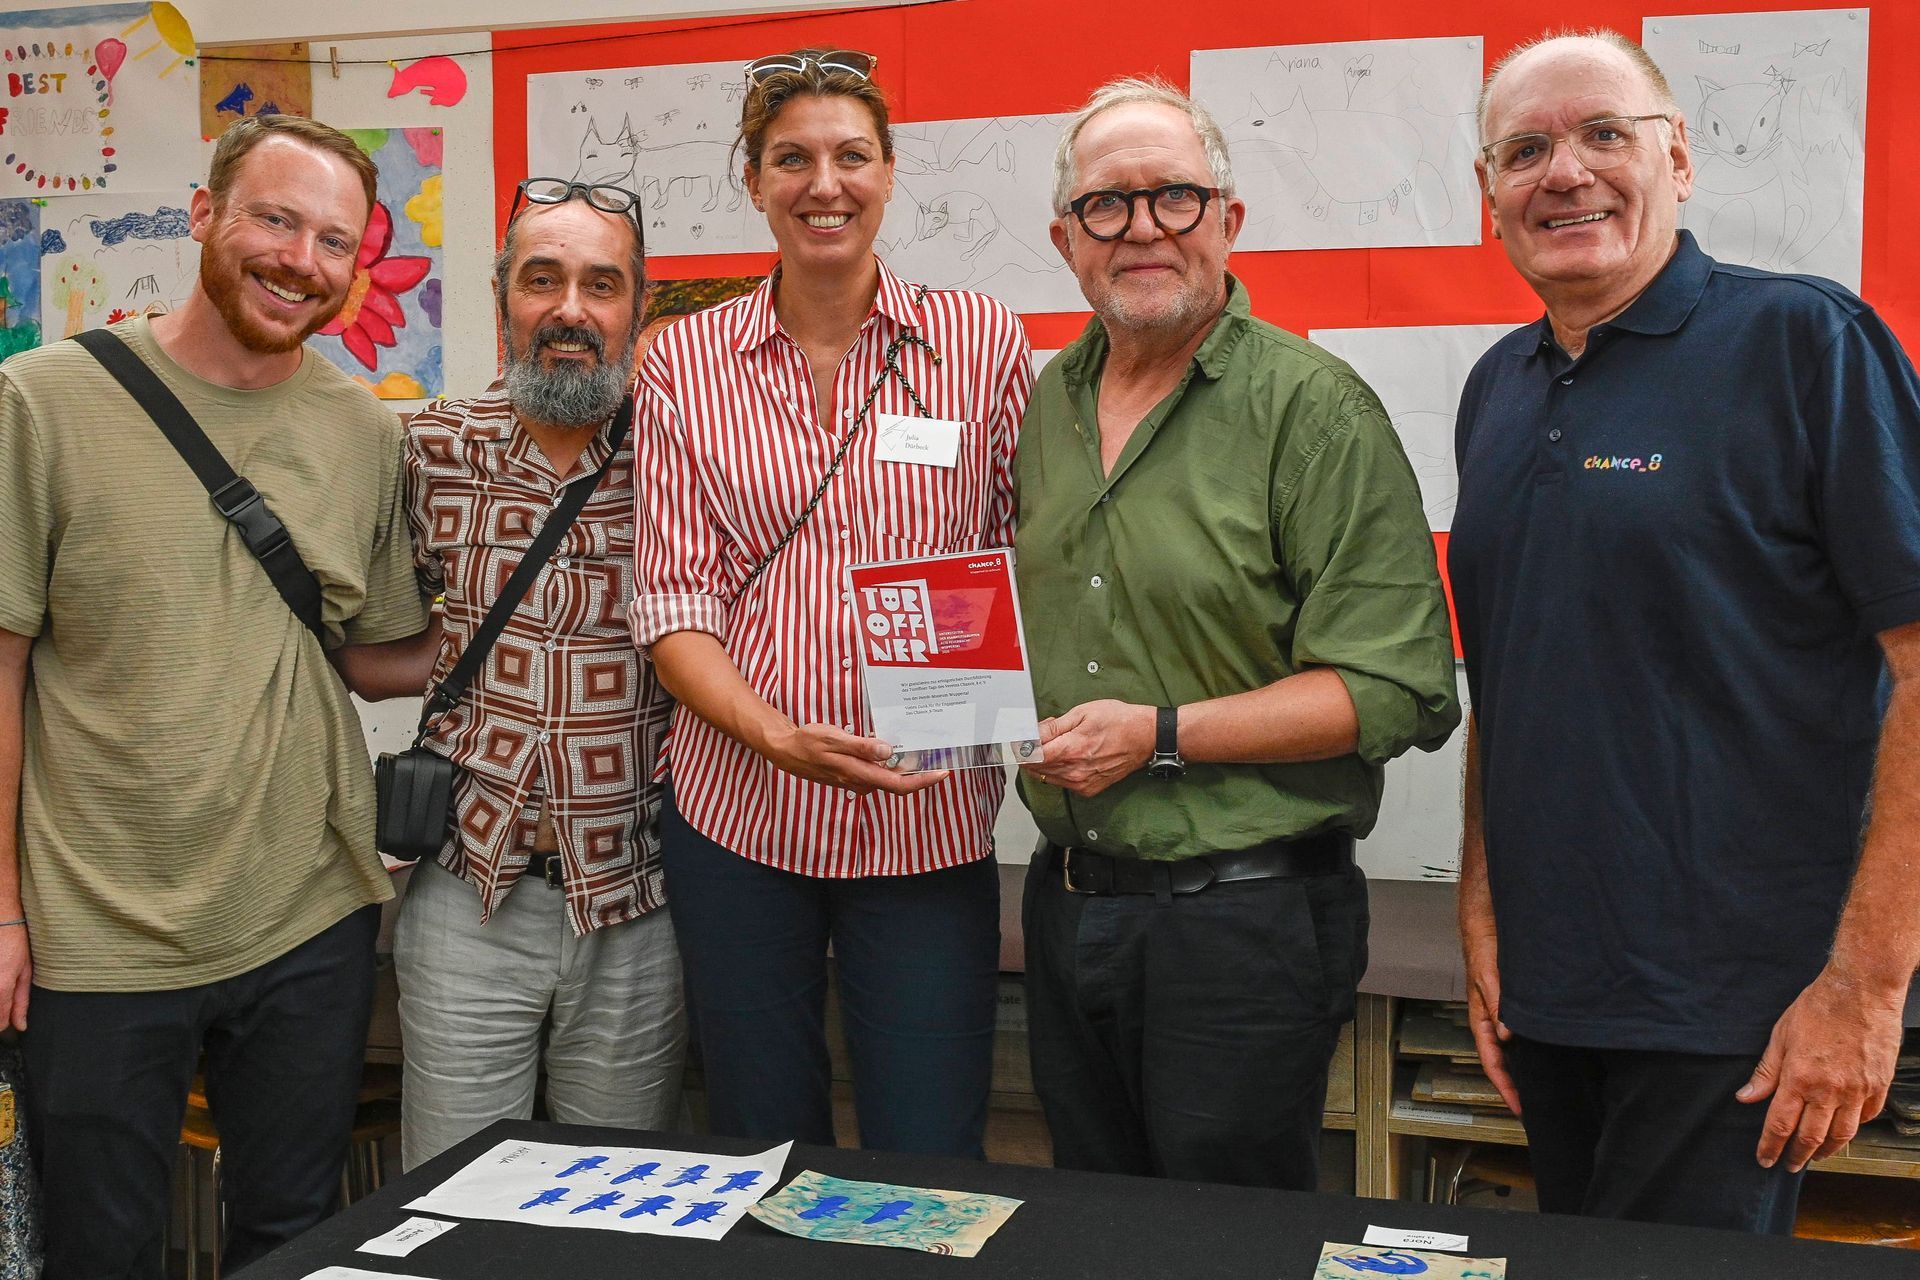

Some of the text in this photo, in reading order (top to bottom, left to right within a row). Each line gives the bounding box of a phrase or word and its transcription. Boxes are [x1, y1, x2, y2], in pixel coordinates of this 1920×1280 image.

[1265, 50, 1323, 73] Ariana
[8, 73, 67, 97] BEST
[870, 638, 931, 662] NER
